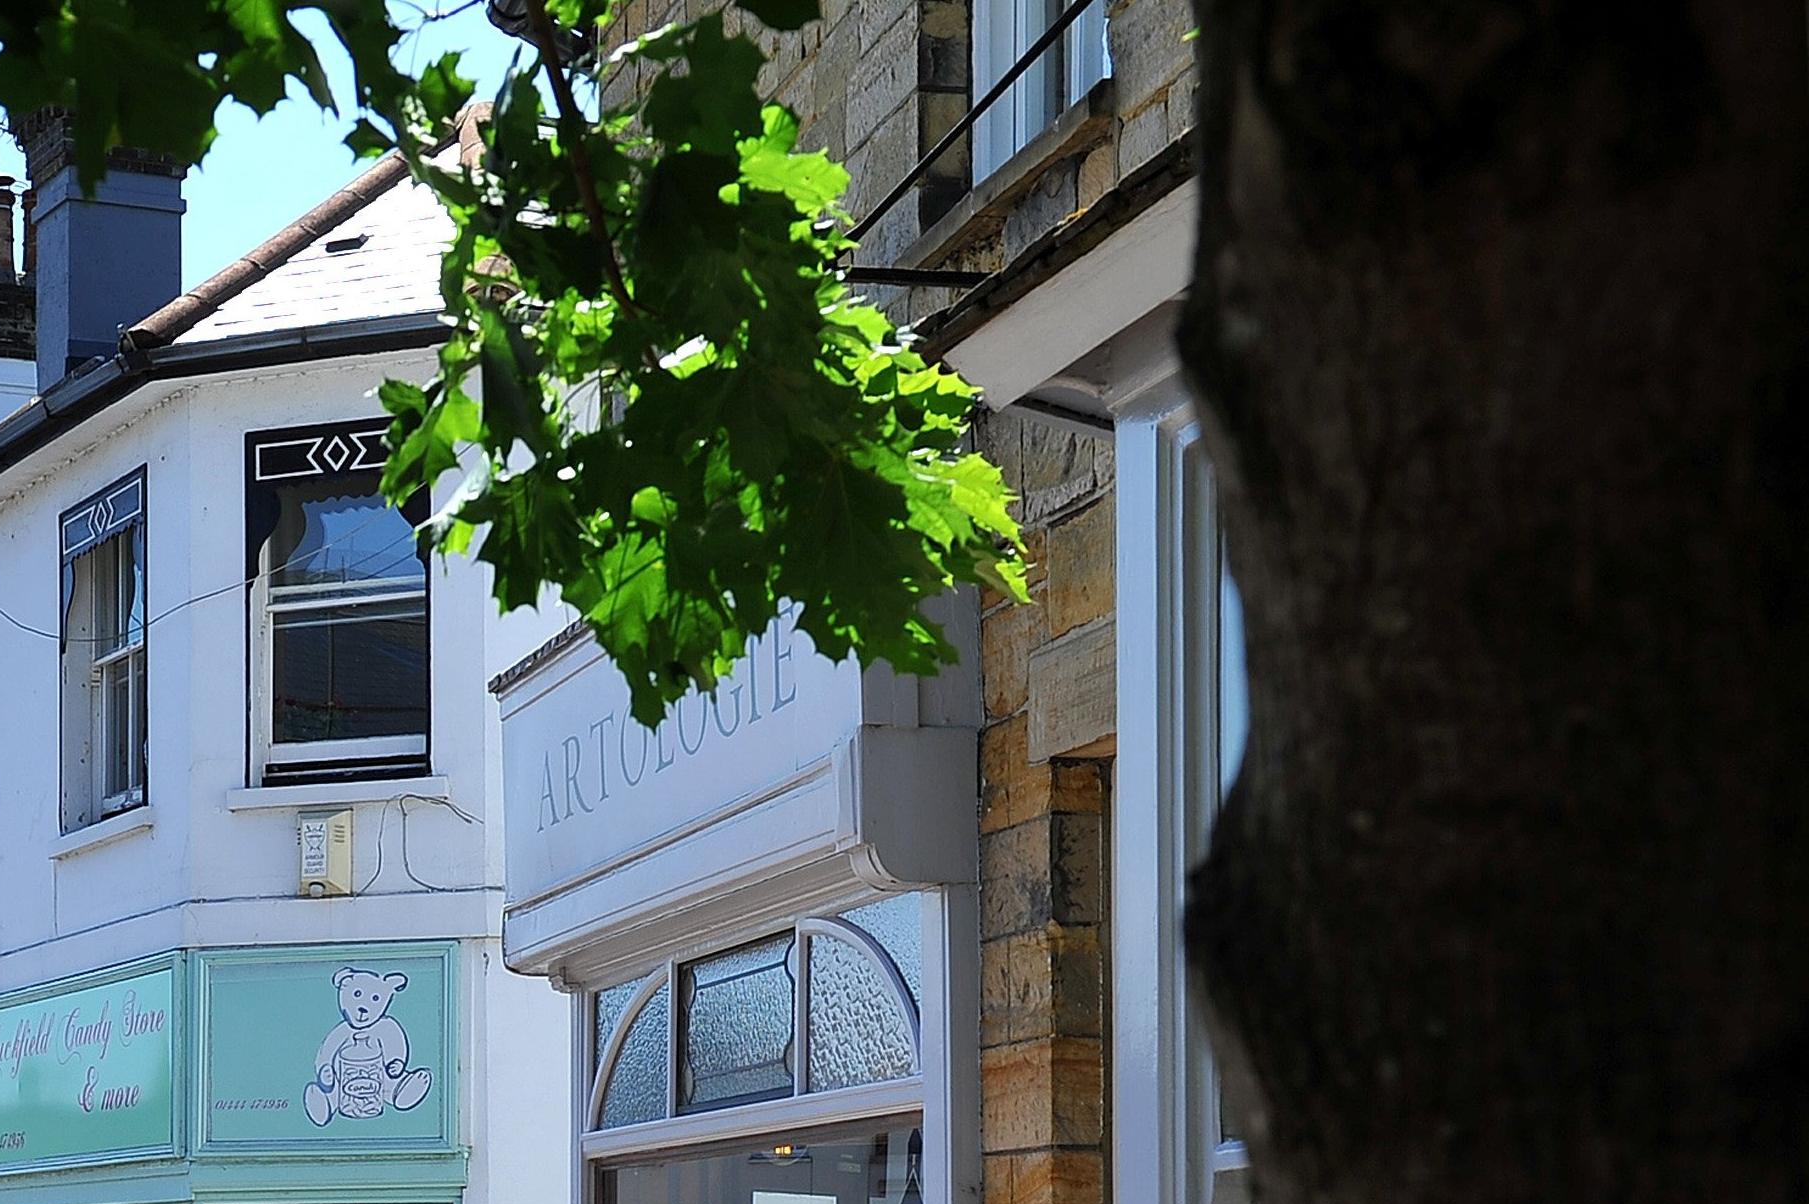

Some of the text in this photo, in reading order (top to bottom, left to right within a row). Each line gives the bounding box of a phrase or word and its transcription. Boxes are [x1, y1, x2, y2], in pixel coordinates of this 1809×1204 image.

[537, 604, 797, 833] ARTOLOGIE
[57, 1000, 113, 1065] Candy
[119, 989, 164, 1047] Store
[101, 1084, 140, 1111] more
